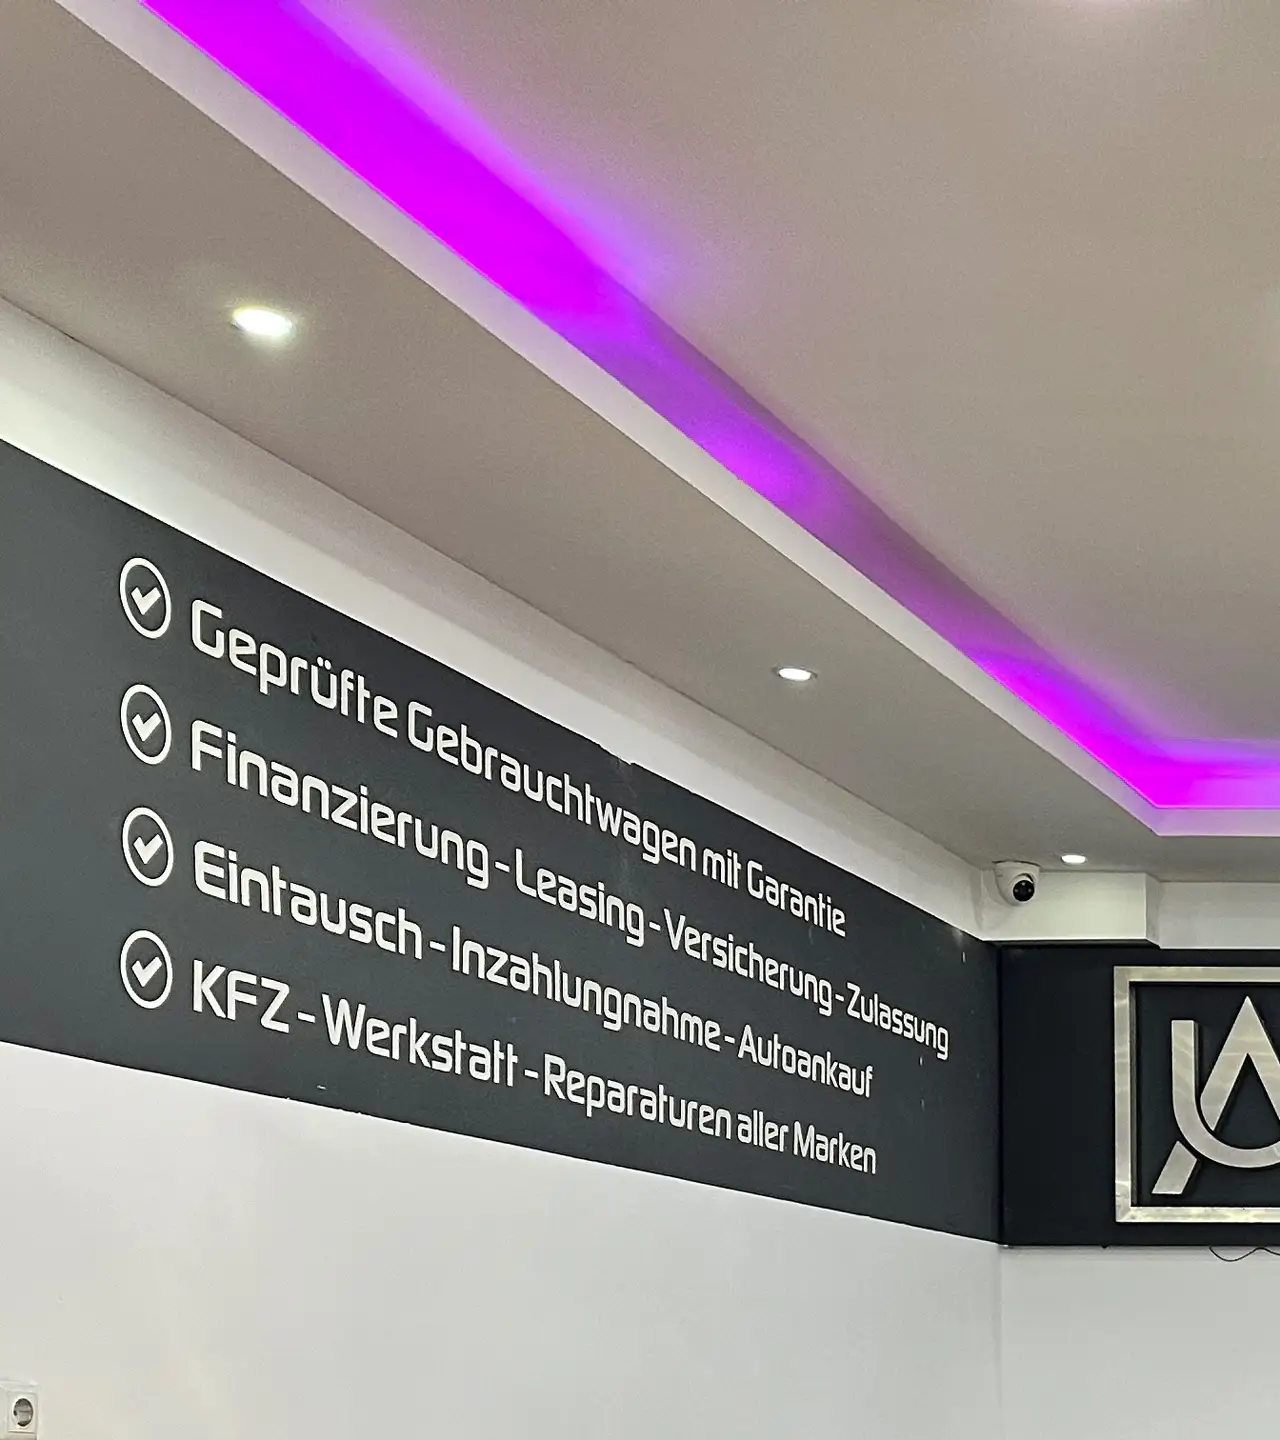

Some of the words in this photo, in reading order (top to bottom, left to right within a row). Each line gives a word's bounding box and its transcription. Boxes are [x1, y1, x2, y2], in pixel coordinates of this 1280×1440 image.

[191, 599, 398, 740] Geprüfte
[408, 701, 697, 872] Gebrauchtwagen
[702, 847, 742, 890] mit
[747, 860, 846, 937] Garantie
[191, 720, 489, 890] Finanzierung
[515, 848, 645, 948] Leasing
[663, 908, 832, 1017] Versicherung
[847, 982, 949, 1061] Zulassung
[193, 959, 290, 1034] KFZ
[321, 993, 519, 1087] Werkstatt
[544, 1053, 732, 1140] Reparaturen
[737, 1109, 789, 1152] aller
[793, 1121, 876, 1175] Marken
[194, 840, 423, 960] Eintausch
[452, 925, 721, 1053] Inzahlungnahme
[737, 1024, 873, 1098] Autoankauf
